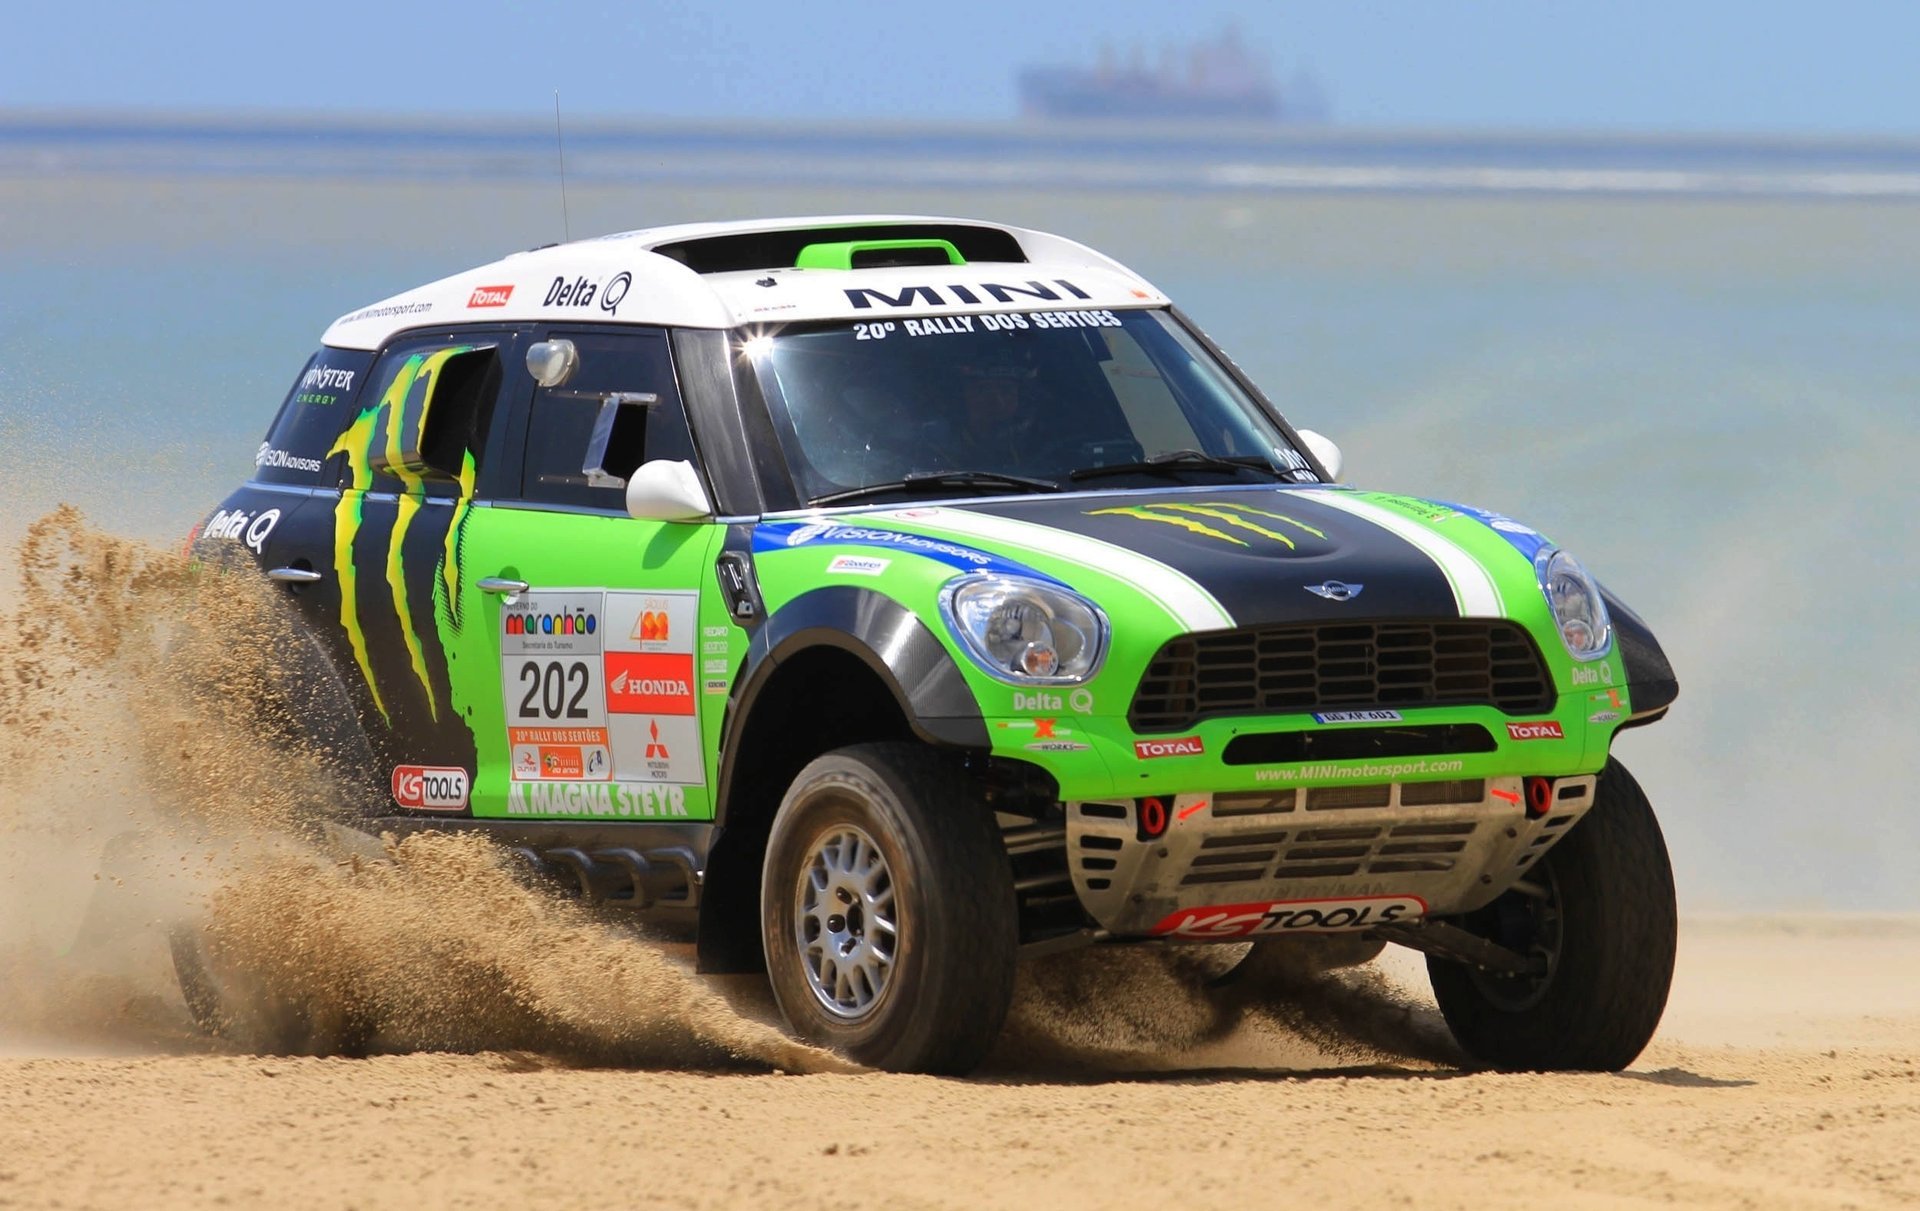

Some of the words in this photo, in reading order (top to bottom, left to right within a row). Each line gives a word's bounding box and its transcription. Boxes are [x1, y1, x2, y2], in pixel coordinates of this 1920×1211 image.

[473, 289, 508, 305] TOTAL
[543, 275, 598, 307] Delta
[601, 270, 632, 317] Q
[843, 279, 1092, 309] MINI
[903, 315, 977, 337] RALLY
[979, 312, 1030, 332] DOS
[296, 393, 337, 405] ENERGY
[246, 508, 280, 554] Q
[506, 604, 597, 635] maranhão
[628, 679, 690, 696] HONDA
[1572, 666, 1598, 686] Delta
[519, 660, 589, 719] 202
[1013, 691, 1062, 710] Delta
[1069, 688, 1093, 715] Q
[1369, 711, 1397, 720] 601
[530, 730, 551, 742] RALLY
[552, 731, 566, 742] DOS
[566, 728, 600, 742] SERTÕES
[1507, 724, 1562, 739] TOTAL
[1042, 743, 1074, 751] WORKS
[1136, 742, 1203, 757] TOTAL
[1255, 760, 1464, 782] www.MINImotorsport.com
[399, 772, 423, 800] KS
[422, 776, 462, 800] TOOLS
[531, 783, 614, 815] MAGNA
[616, 784, 688, 816] STEYR
[1262, 904, 1407, 931] TOOLS
